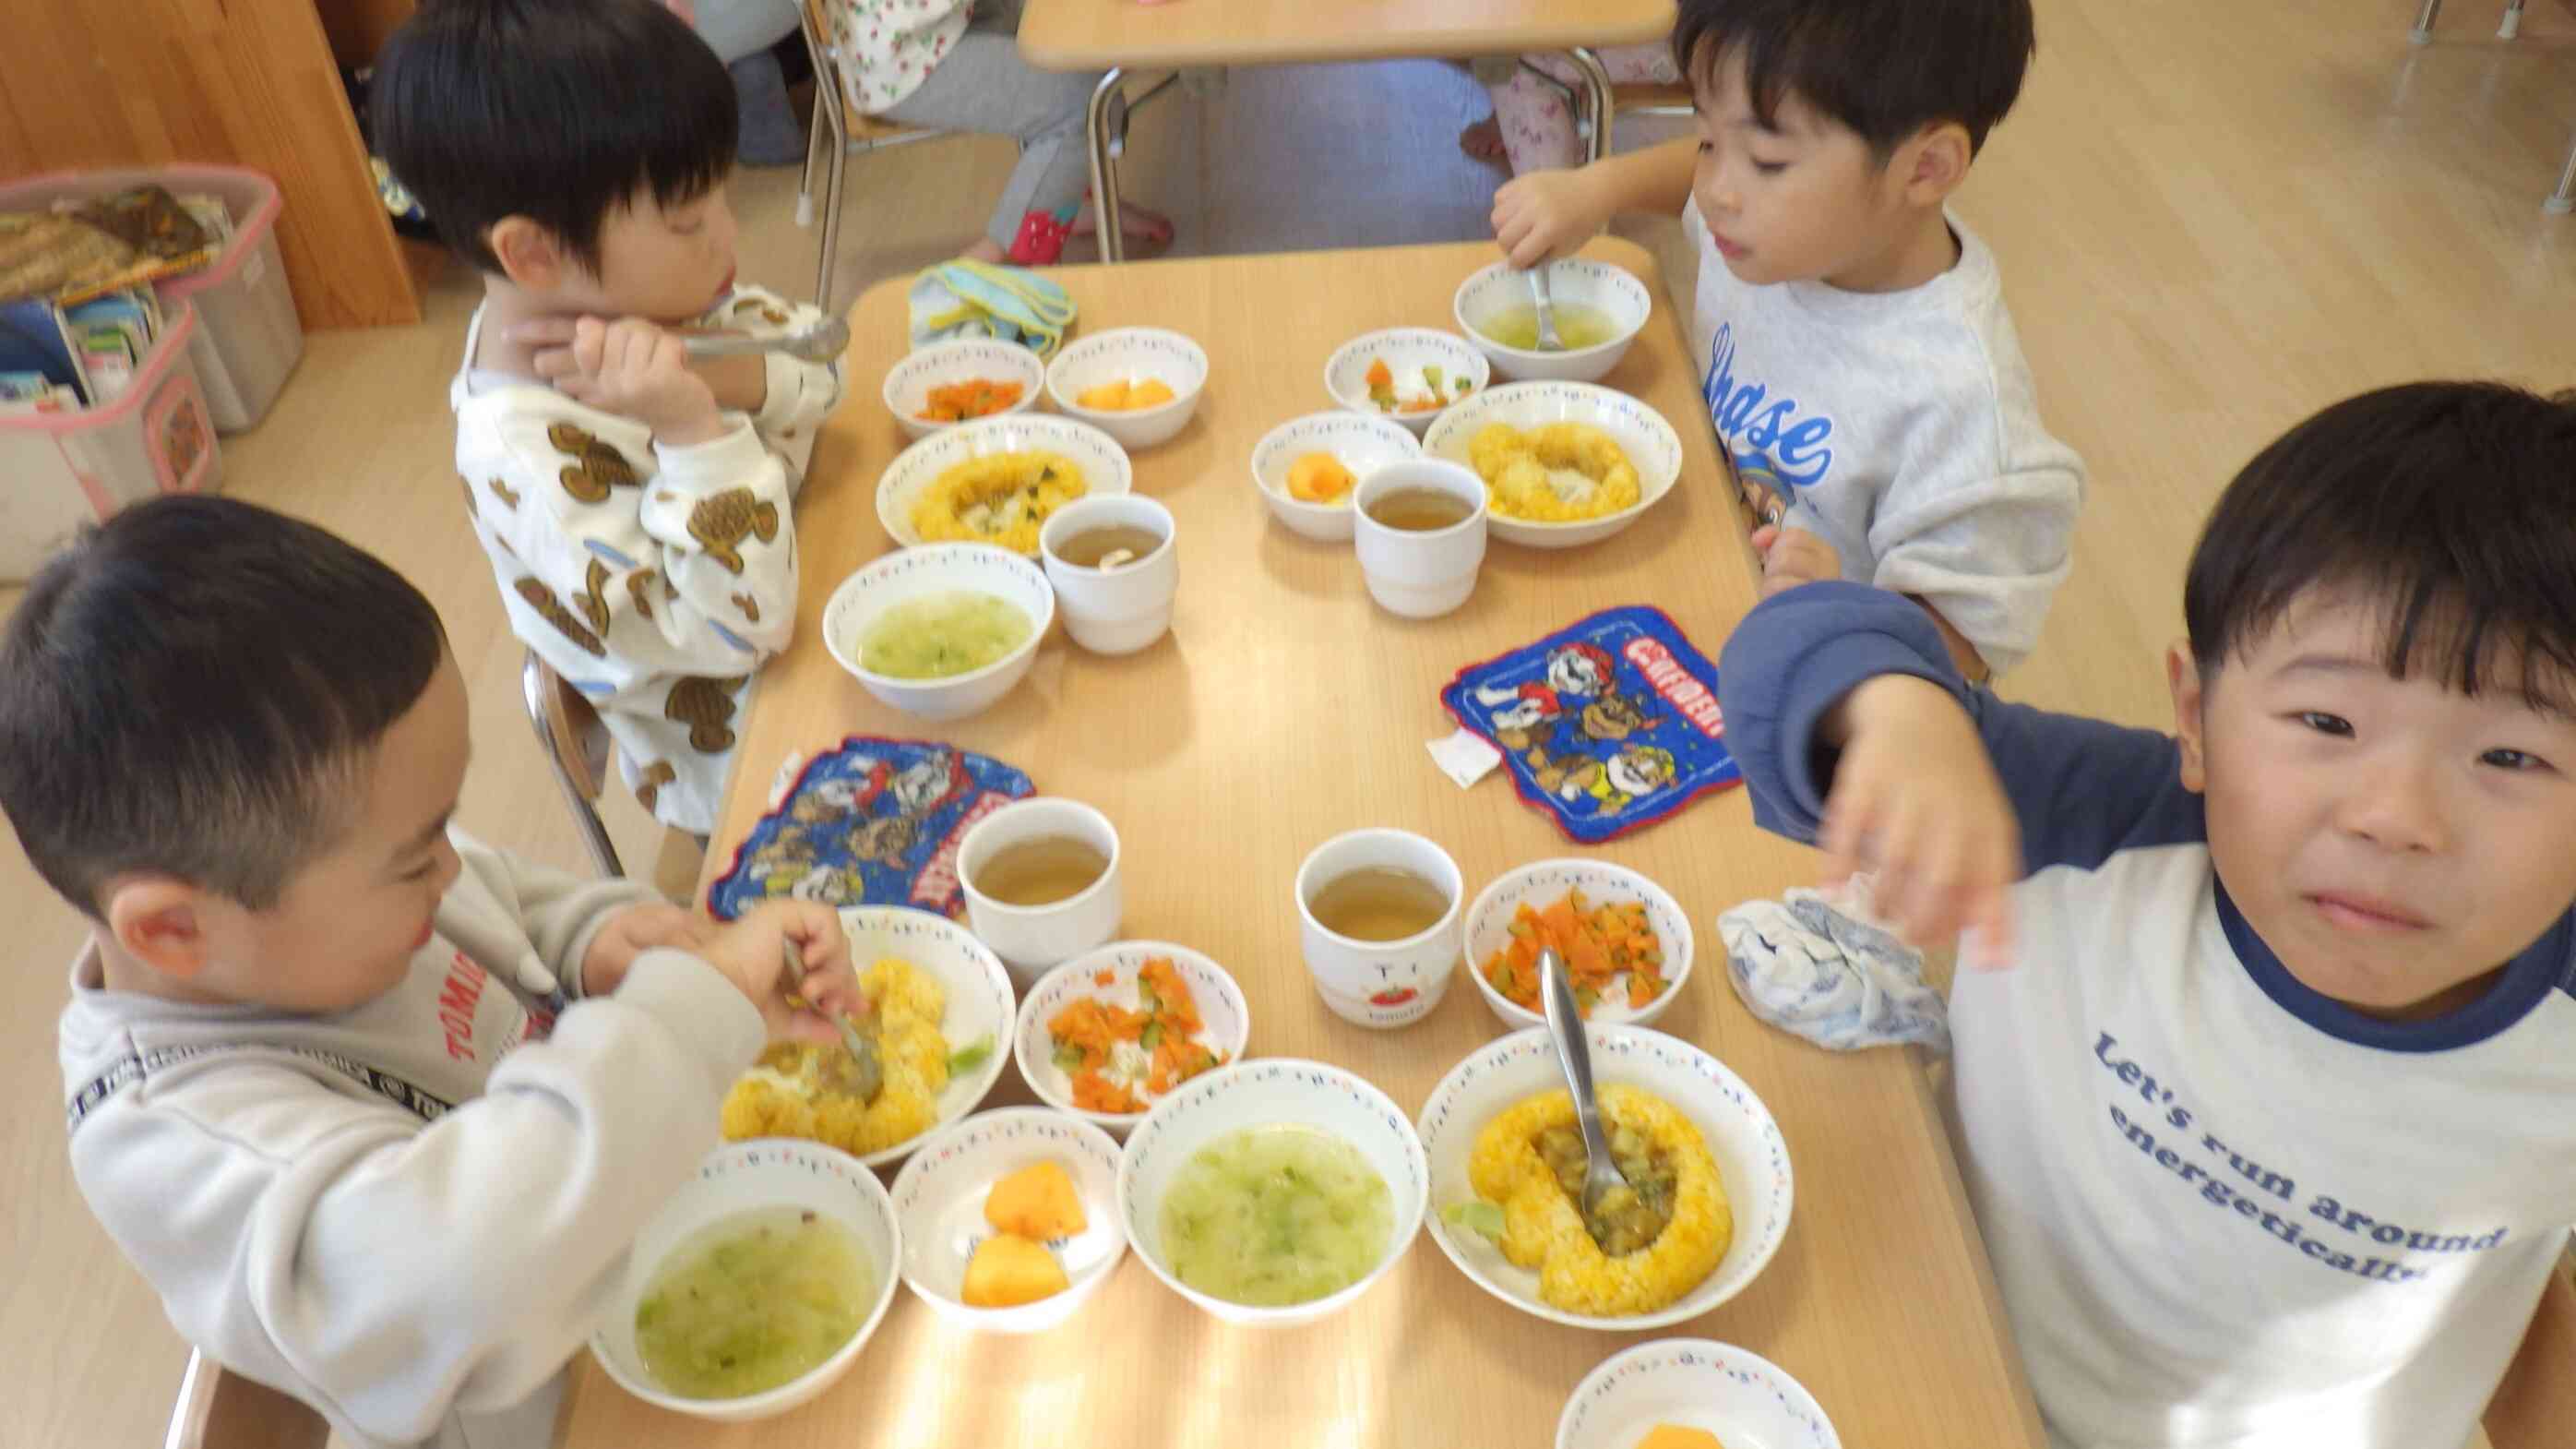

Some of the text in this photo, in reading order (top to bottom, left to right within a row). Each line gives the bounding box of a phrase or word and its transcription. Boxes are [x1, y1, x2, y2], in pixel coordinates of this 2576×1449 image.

[2093, 1030, 2510, 1251] Let's run around
